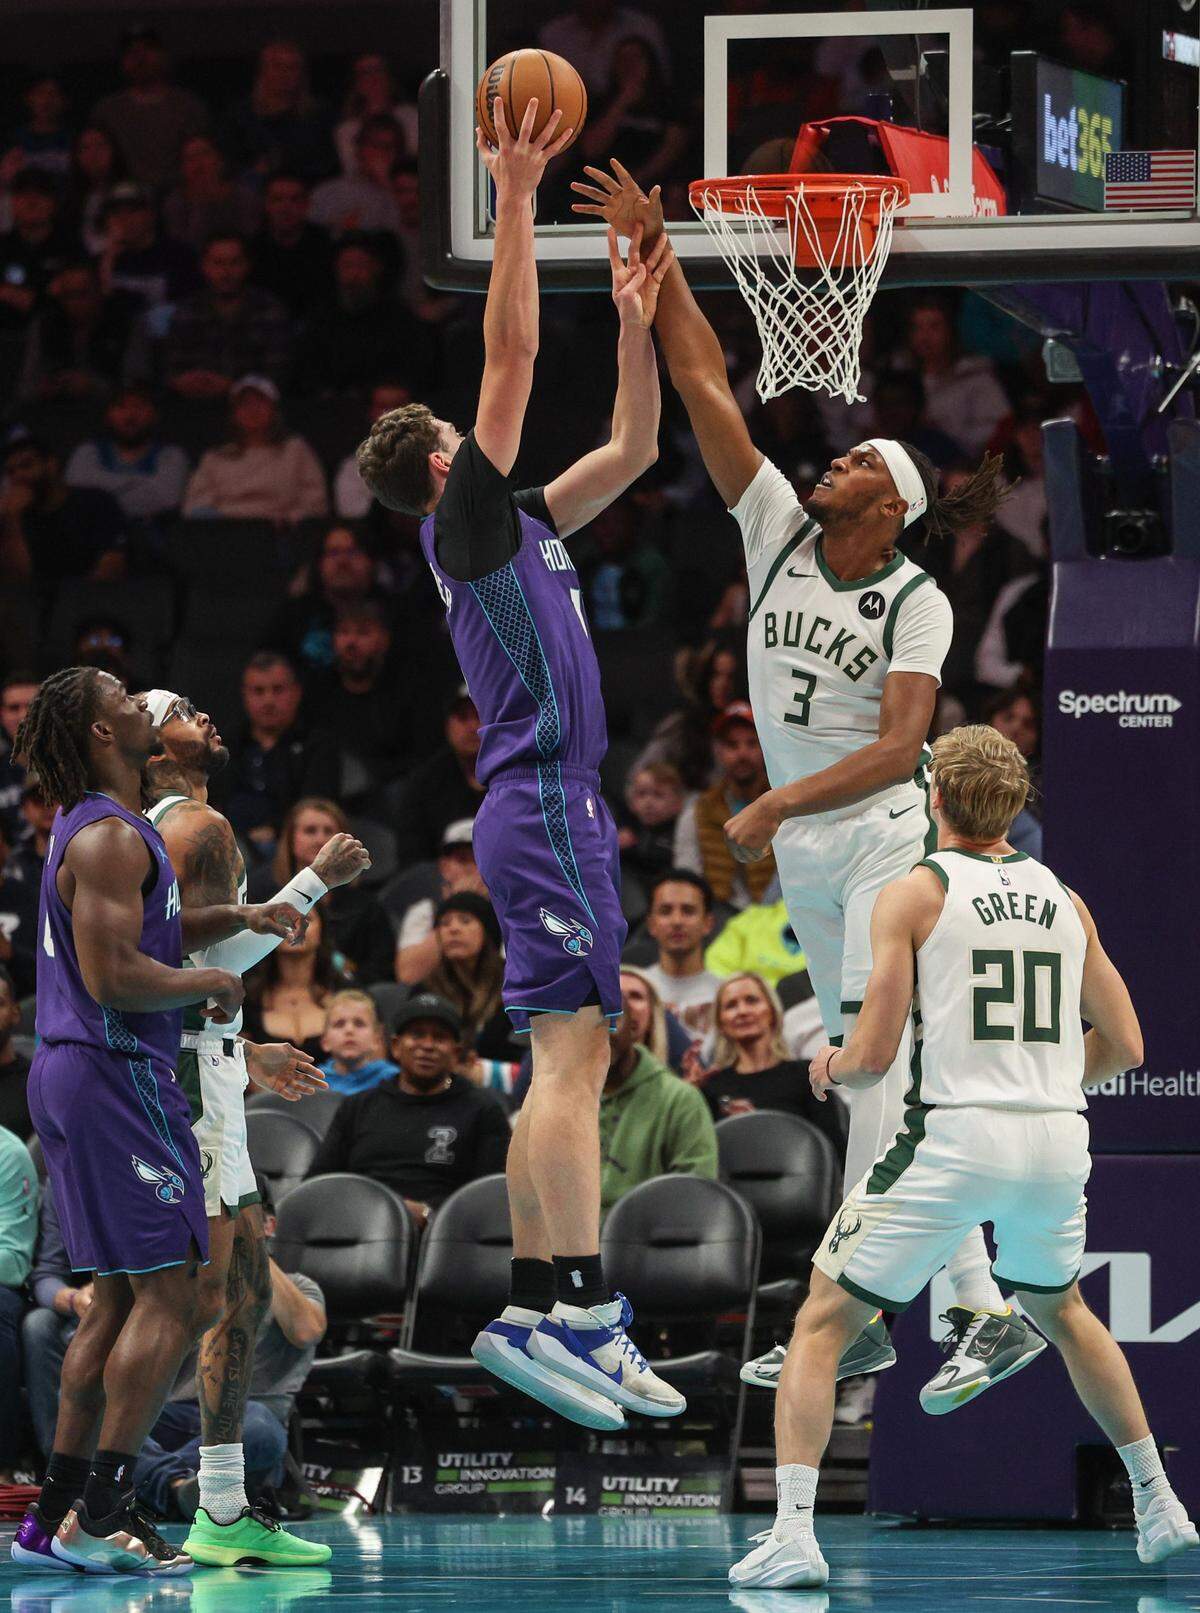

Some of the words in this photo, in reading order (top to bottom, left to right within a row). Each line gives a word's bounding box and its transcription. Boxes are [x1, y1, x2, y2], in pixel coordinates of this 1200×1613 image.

[1044, 93, 1113, 181] bet365
[765, 611, 878, 682] BUCKS
[784, 669, 817, 726] 3
[1058, 690, 1182, 719] Spectrum
[1119, 714, 1173, 728] CENTER
[972, 892, 1057, 930] GREEN
[971, 949, 1062, 1044] 20
[437, 1453, 513, 1468] UTILITY
[402, 1466, 422, 1484] 13
[460, 1468, 556, 1481] INNOVATION
[434, 1483, 486, 1495] GROUP
[602, 1476, 679, 1492] UTILITY
[565, 1487, 586, 1505] 14
[623, 1494, 722, 1507] INNOVATION
